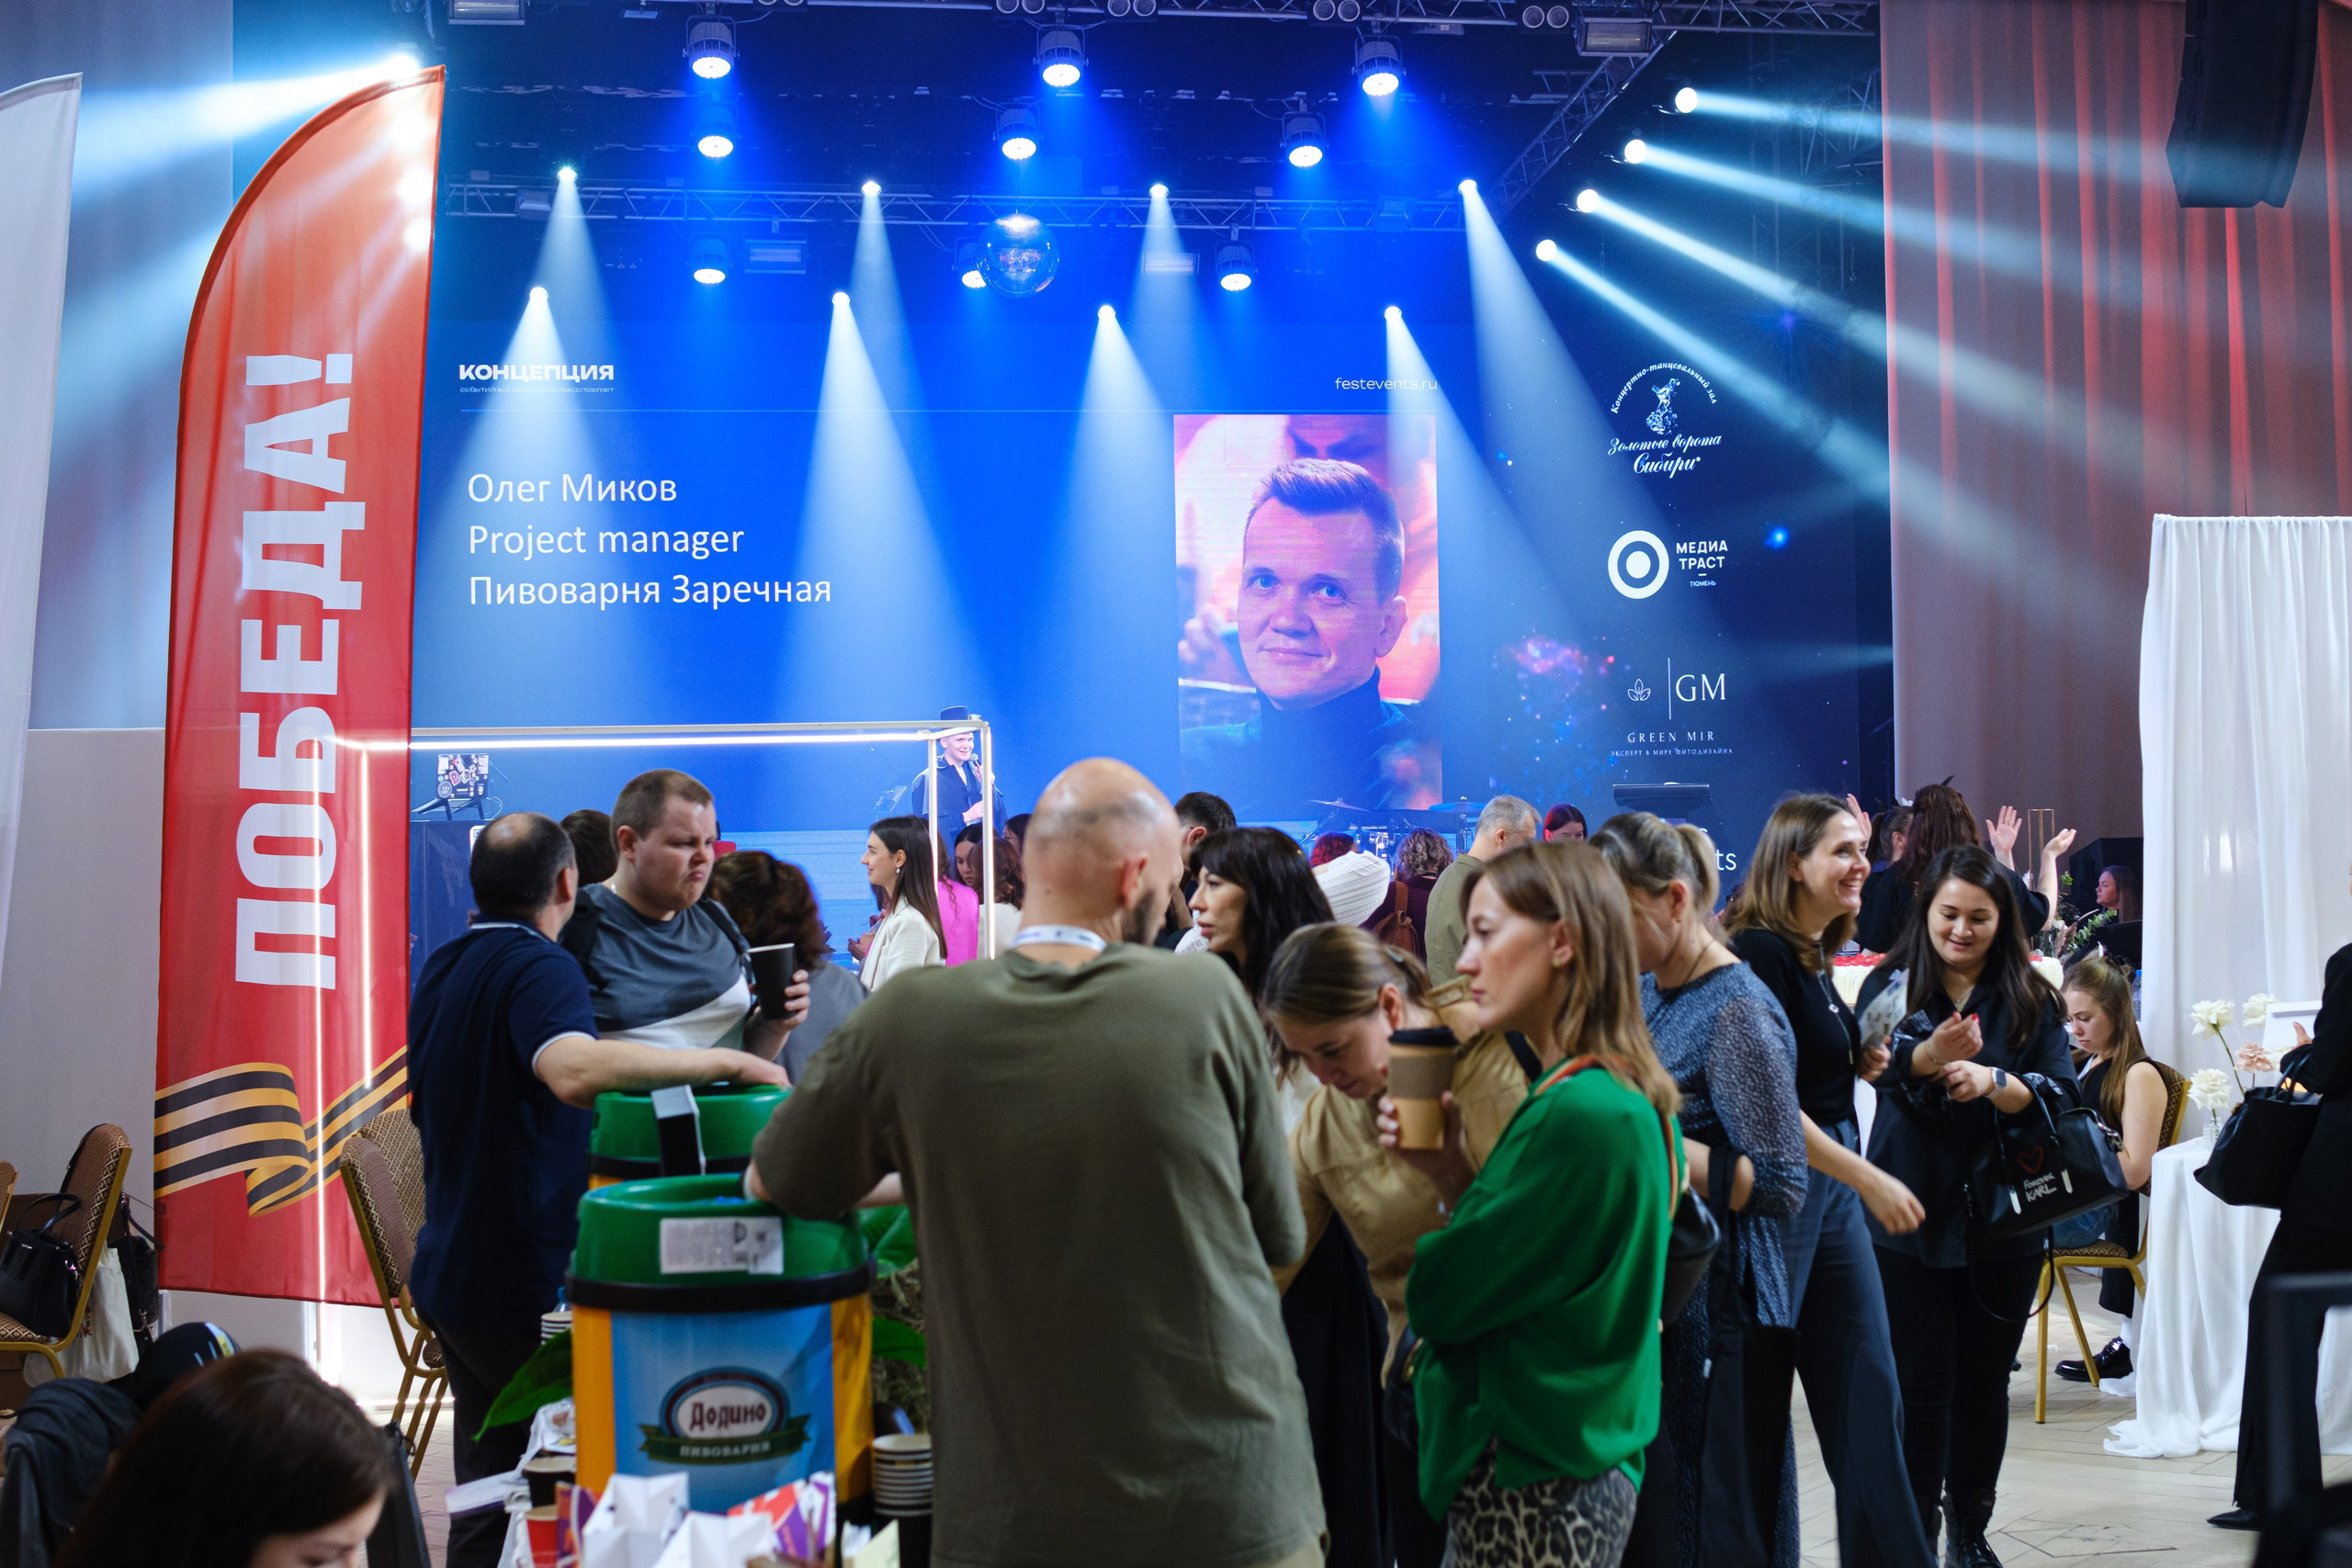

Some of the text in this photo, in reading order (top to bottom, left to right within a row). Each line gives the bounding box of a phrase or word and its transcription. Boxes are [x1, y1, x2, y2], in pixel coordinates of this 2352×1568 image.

[458, 364, 615, 383] КОНЦЕПЦИЯ
[1335, 377, 1438, 390] festevents.ru
[1607, 434, 1722, 456] Золотые ворота
[468, 472, 678, 502] Олег Миков
[469, 525, 745, 561] Project manager
[1676, 539, 1728, 555] МЕДИА
[1679, 556, 1725, 570] ТРАСТ
[469, 573, 831, 611] Пивоварня Заречная
[235, 353, 365, 990] ПОБЕДА!
[1675, 672, 1726, 702] GM
[1627, 730, 1714, 743] GREEN MIR
[2025, 1184, 2057, 1202] KARL
[690, 1401, 767, 1432] Додино
